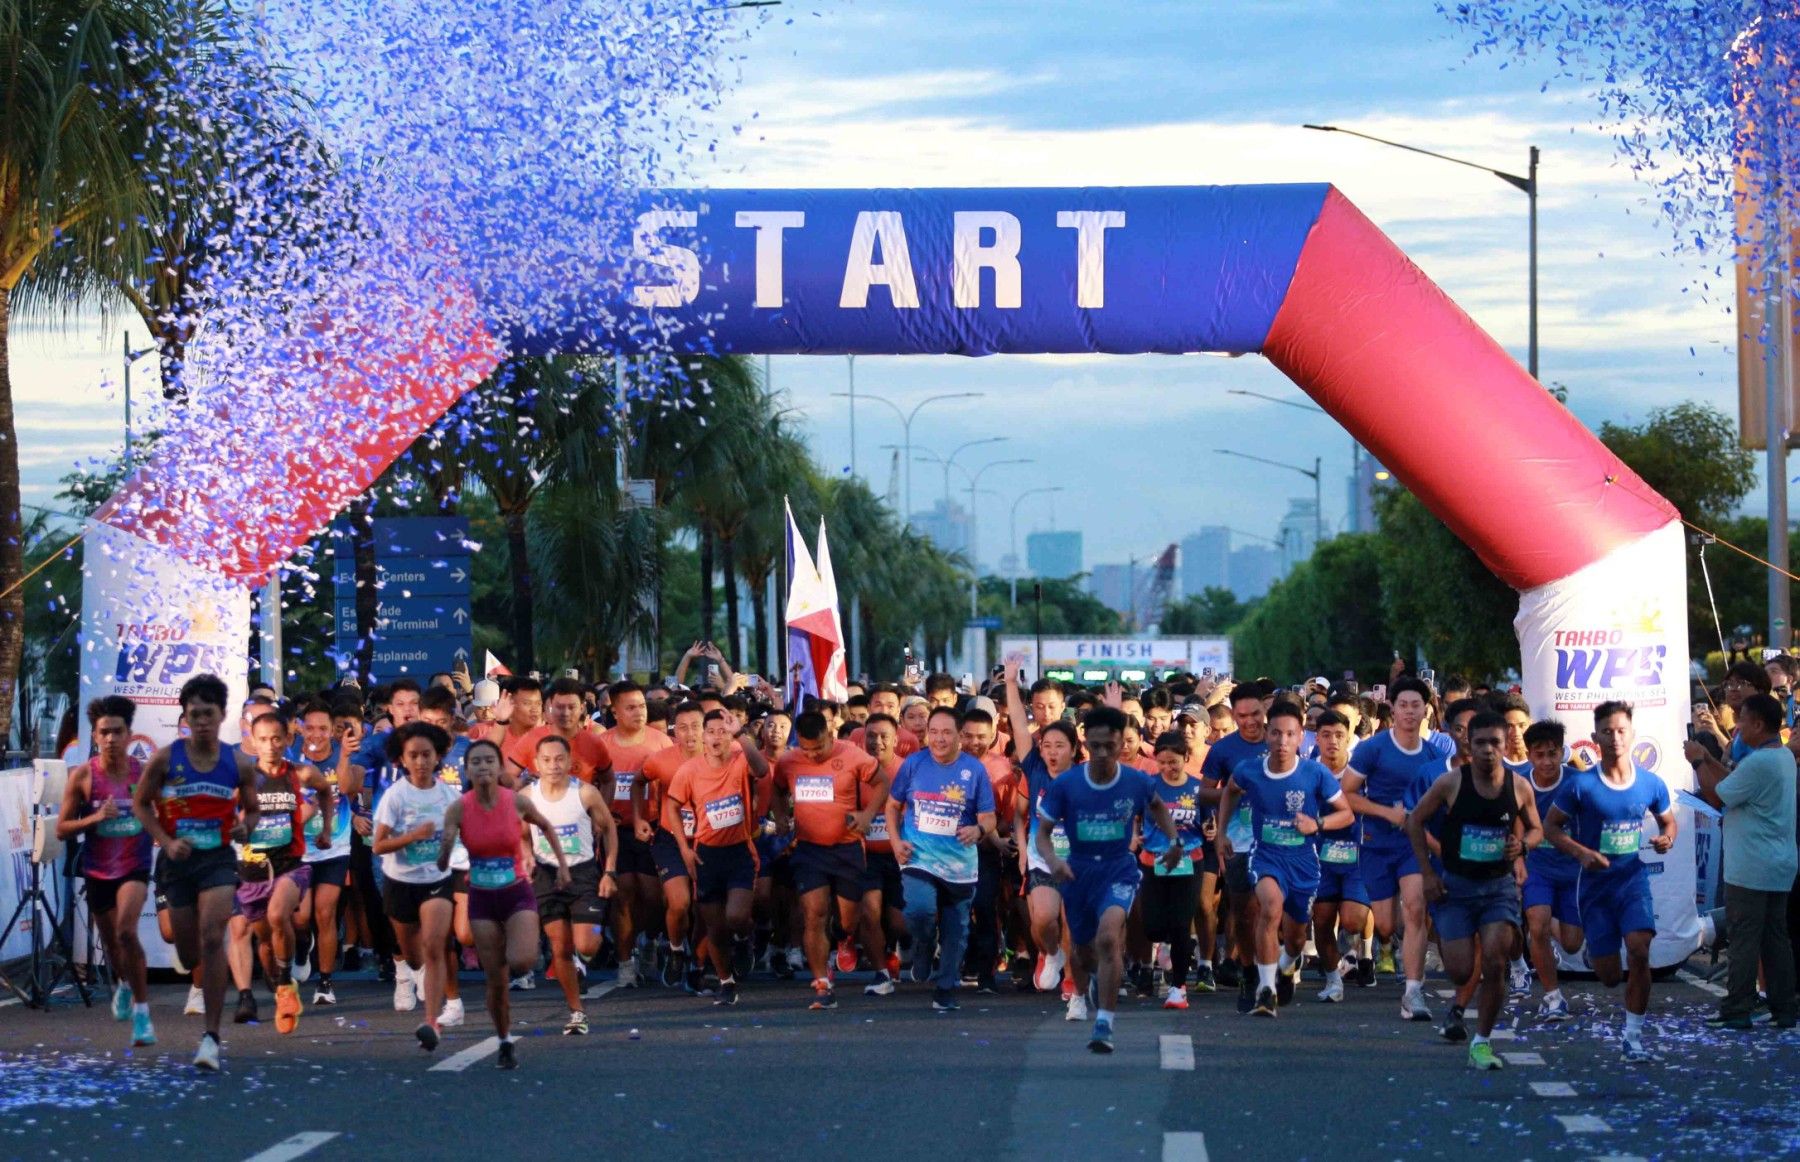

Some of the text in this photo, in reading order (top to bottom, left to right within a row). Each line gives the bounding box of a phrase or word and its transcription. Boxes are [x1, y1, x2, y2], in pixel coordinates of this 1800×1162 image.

[632, 210, 1126, 309] START
[382, 572, 426, 582] Centers
[392, 618, 439, 630] Terminal
[1554, 630, 1623, 646] TAKBO
[1077, 643, 1153, 658] FINISH
[372, 651, 428, 663] Esplanade
[1554, 644, 1667, 689] WPS
[114, 685, 182, 697] WEST PHILIP
[1555, 692, 1582, 701] WEST
[617, 785, 633, 793] 177
[800, 788, 829, 798] 17760
[256, 792, 297, 804] PATERO
[713, 807, 742, 822] 17762
[925, 816, 951, 828] 17751
